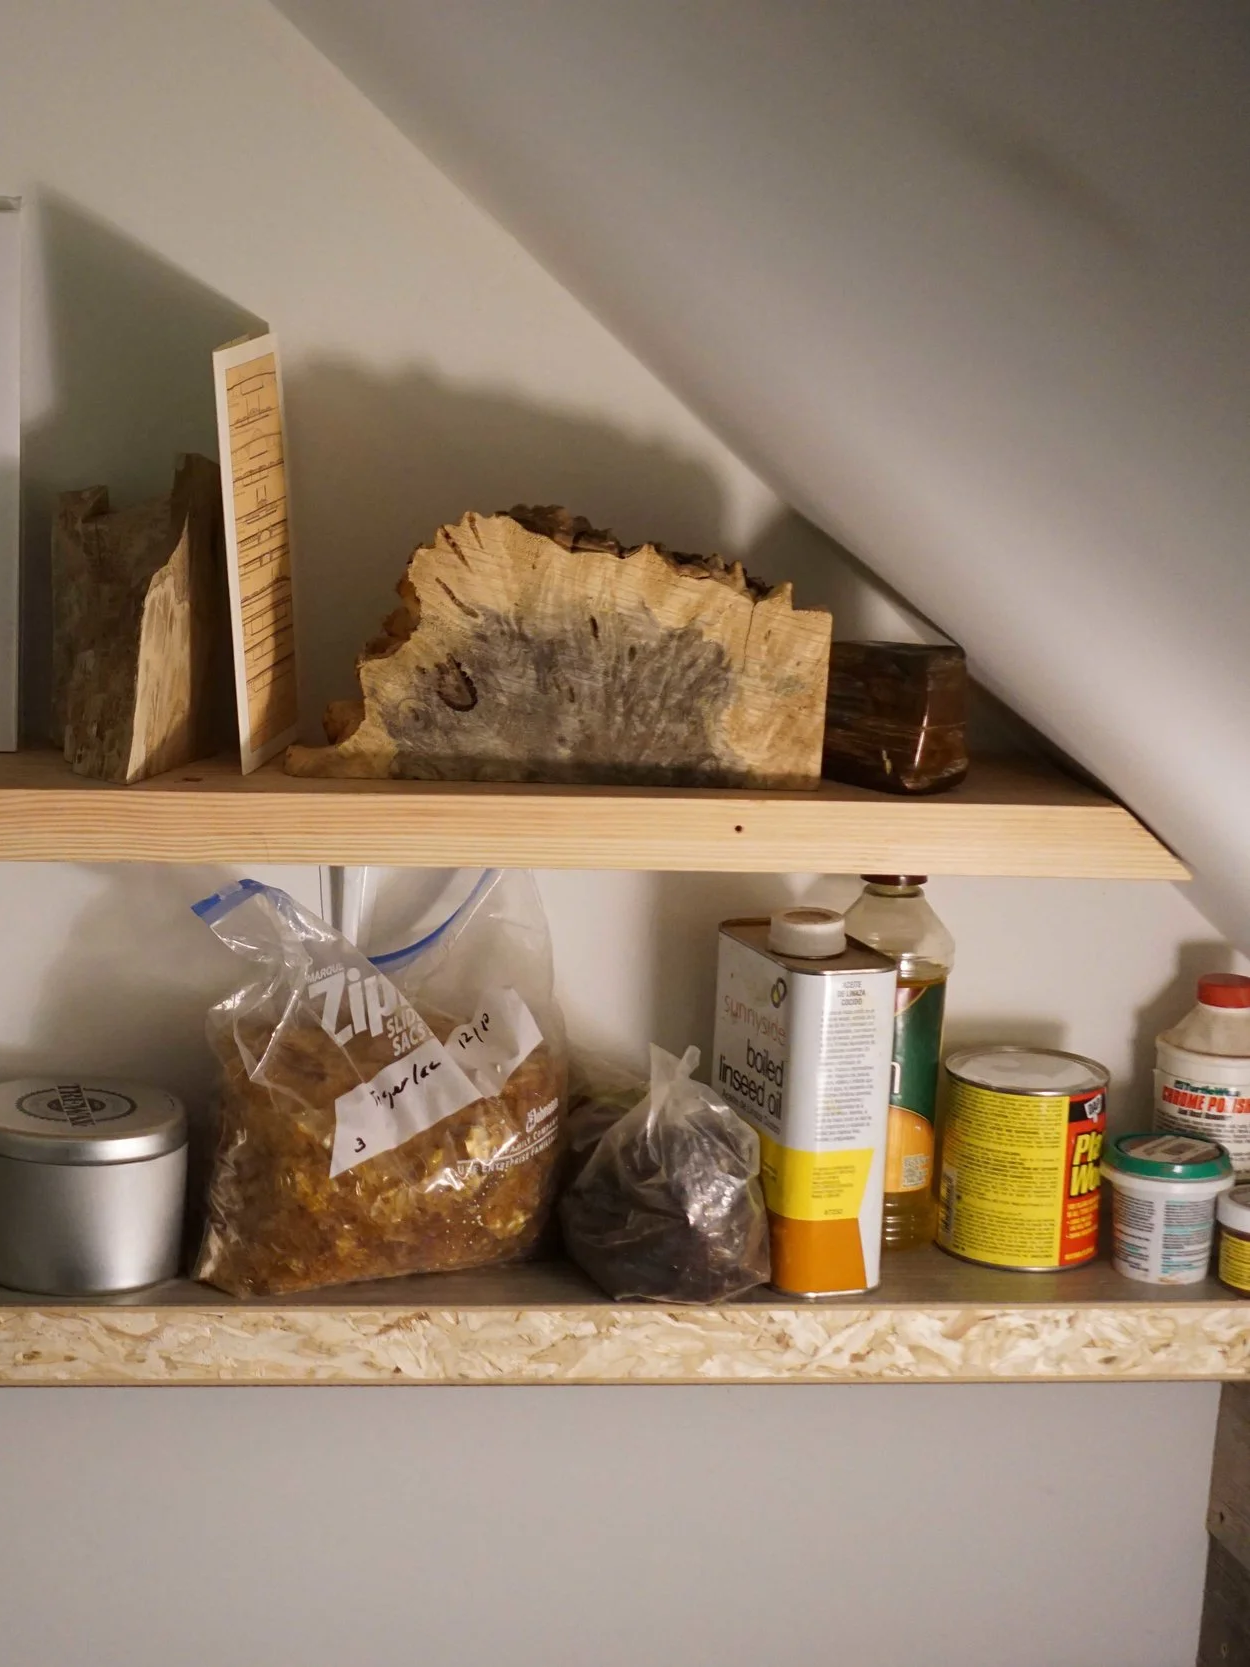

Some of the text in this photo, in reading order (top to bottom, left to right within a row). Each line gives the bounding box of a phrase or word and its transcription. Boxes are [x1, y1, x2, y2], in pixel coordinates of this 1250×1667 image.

[724, 994, 787, 1047] sunnyside
[719, 1054, 783, 1120] linseed oil
[746, 1039, 784, 1088] boiled
[1162, 1085, 1206, 1111] CHROME
[354, 1137, 367, 1153] 3
